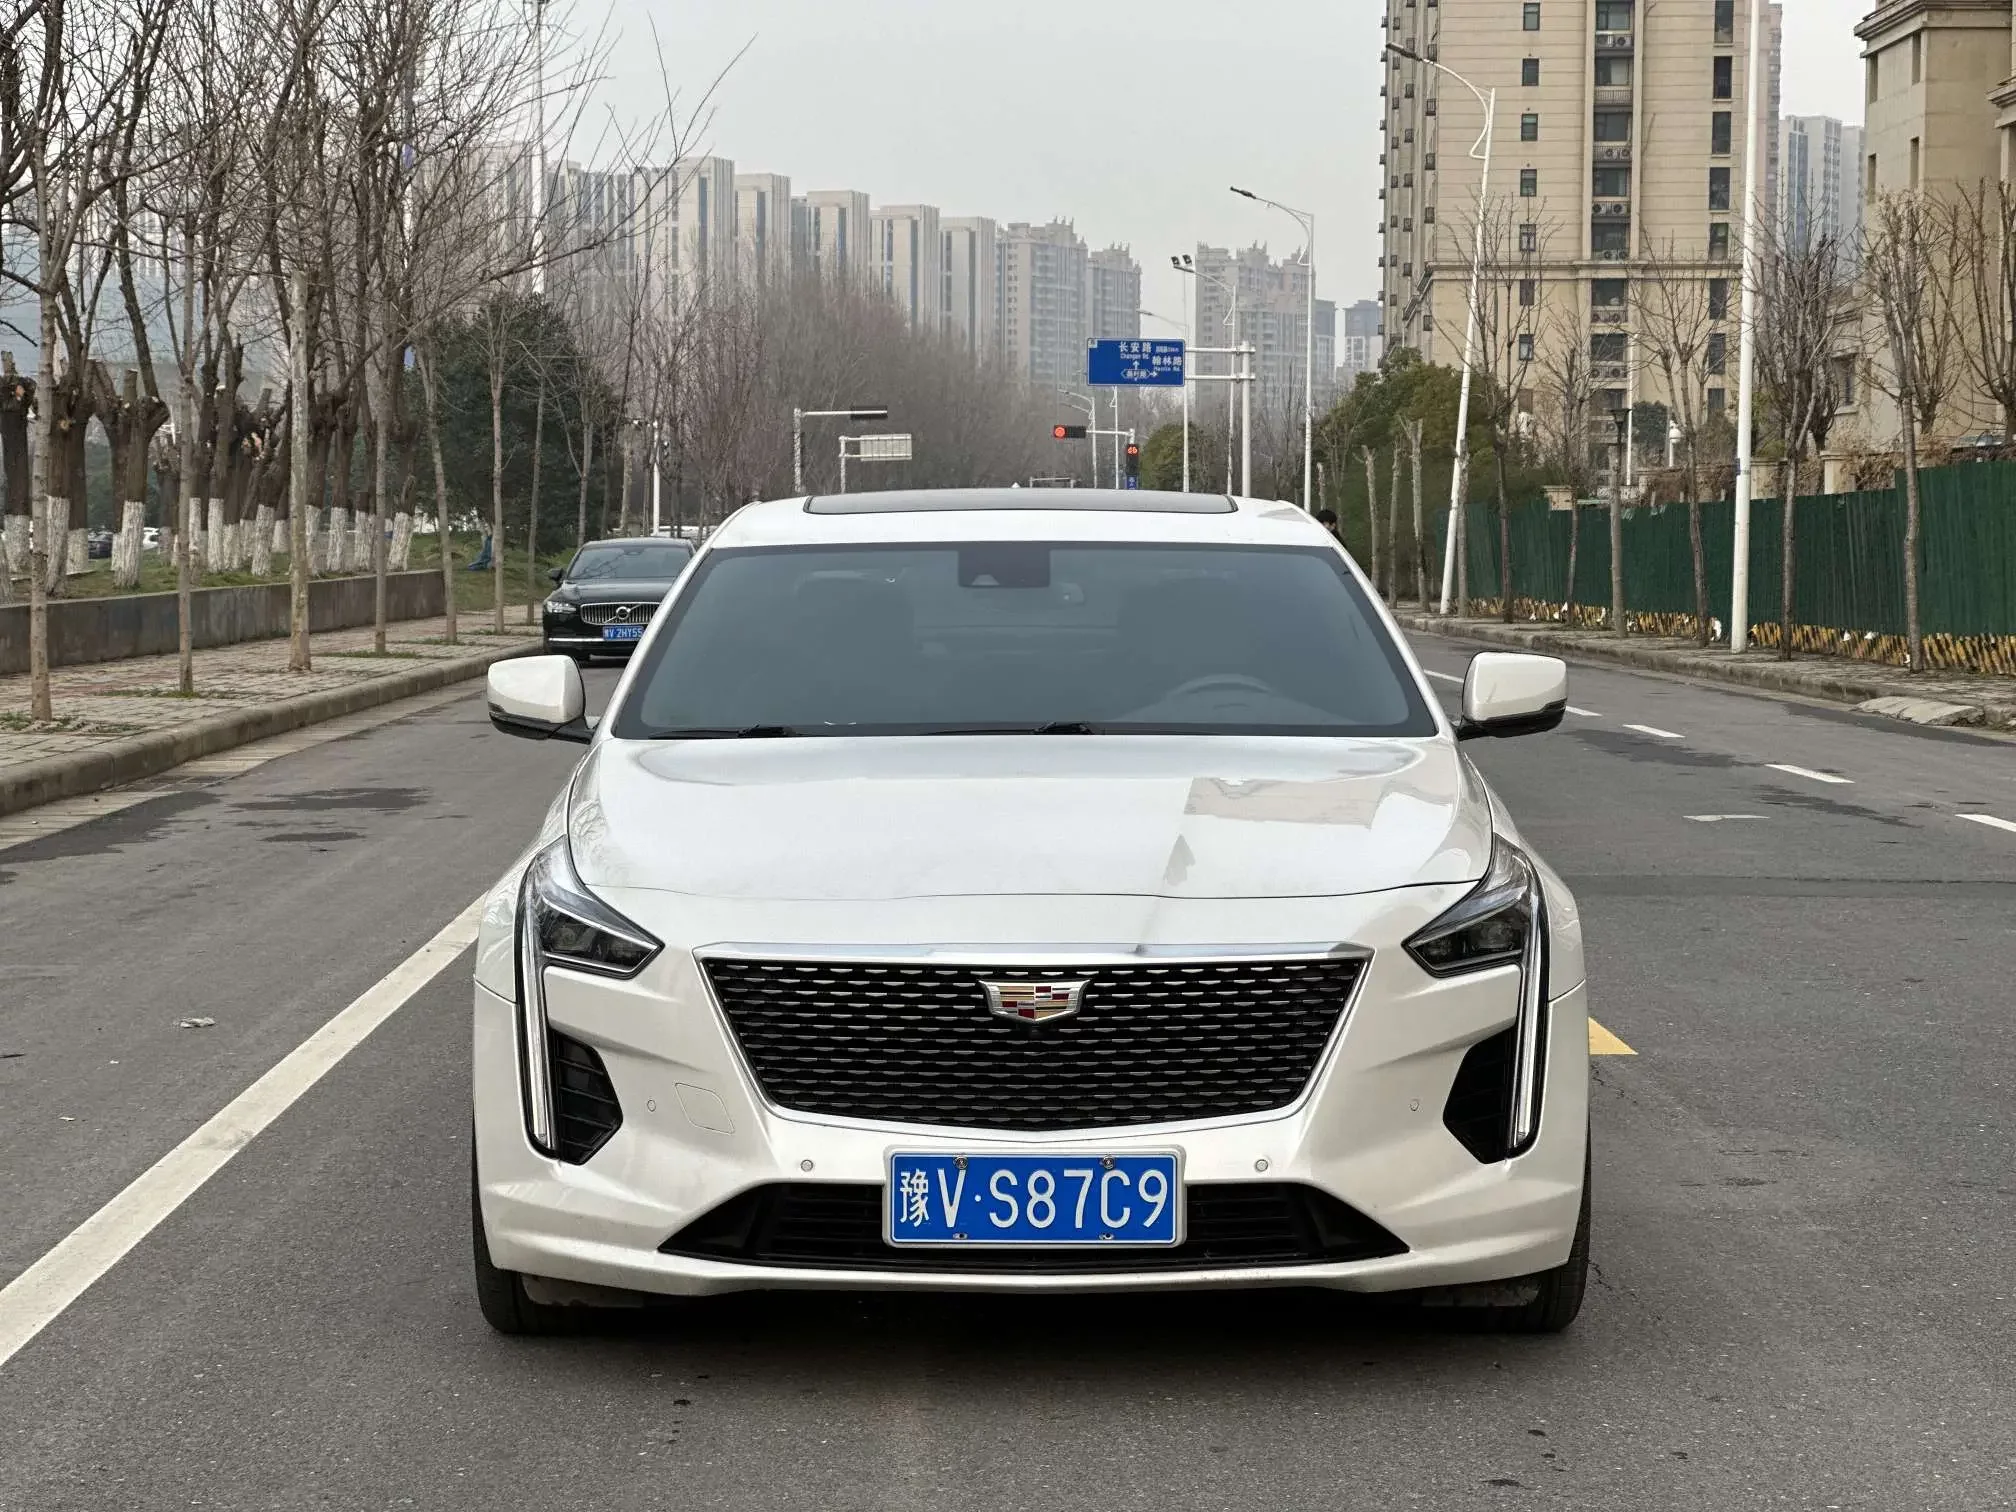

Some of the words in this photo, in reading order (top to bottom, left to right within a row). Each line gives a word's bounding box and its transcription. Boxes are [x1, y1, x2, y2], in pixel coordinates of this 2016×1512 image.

[1119, 342, 1152, 352] 长安路
[900, 1168, 1168, 1228] 豫V·S87C9
